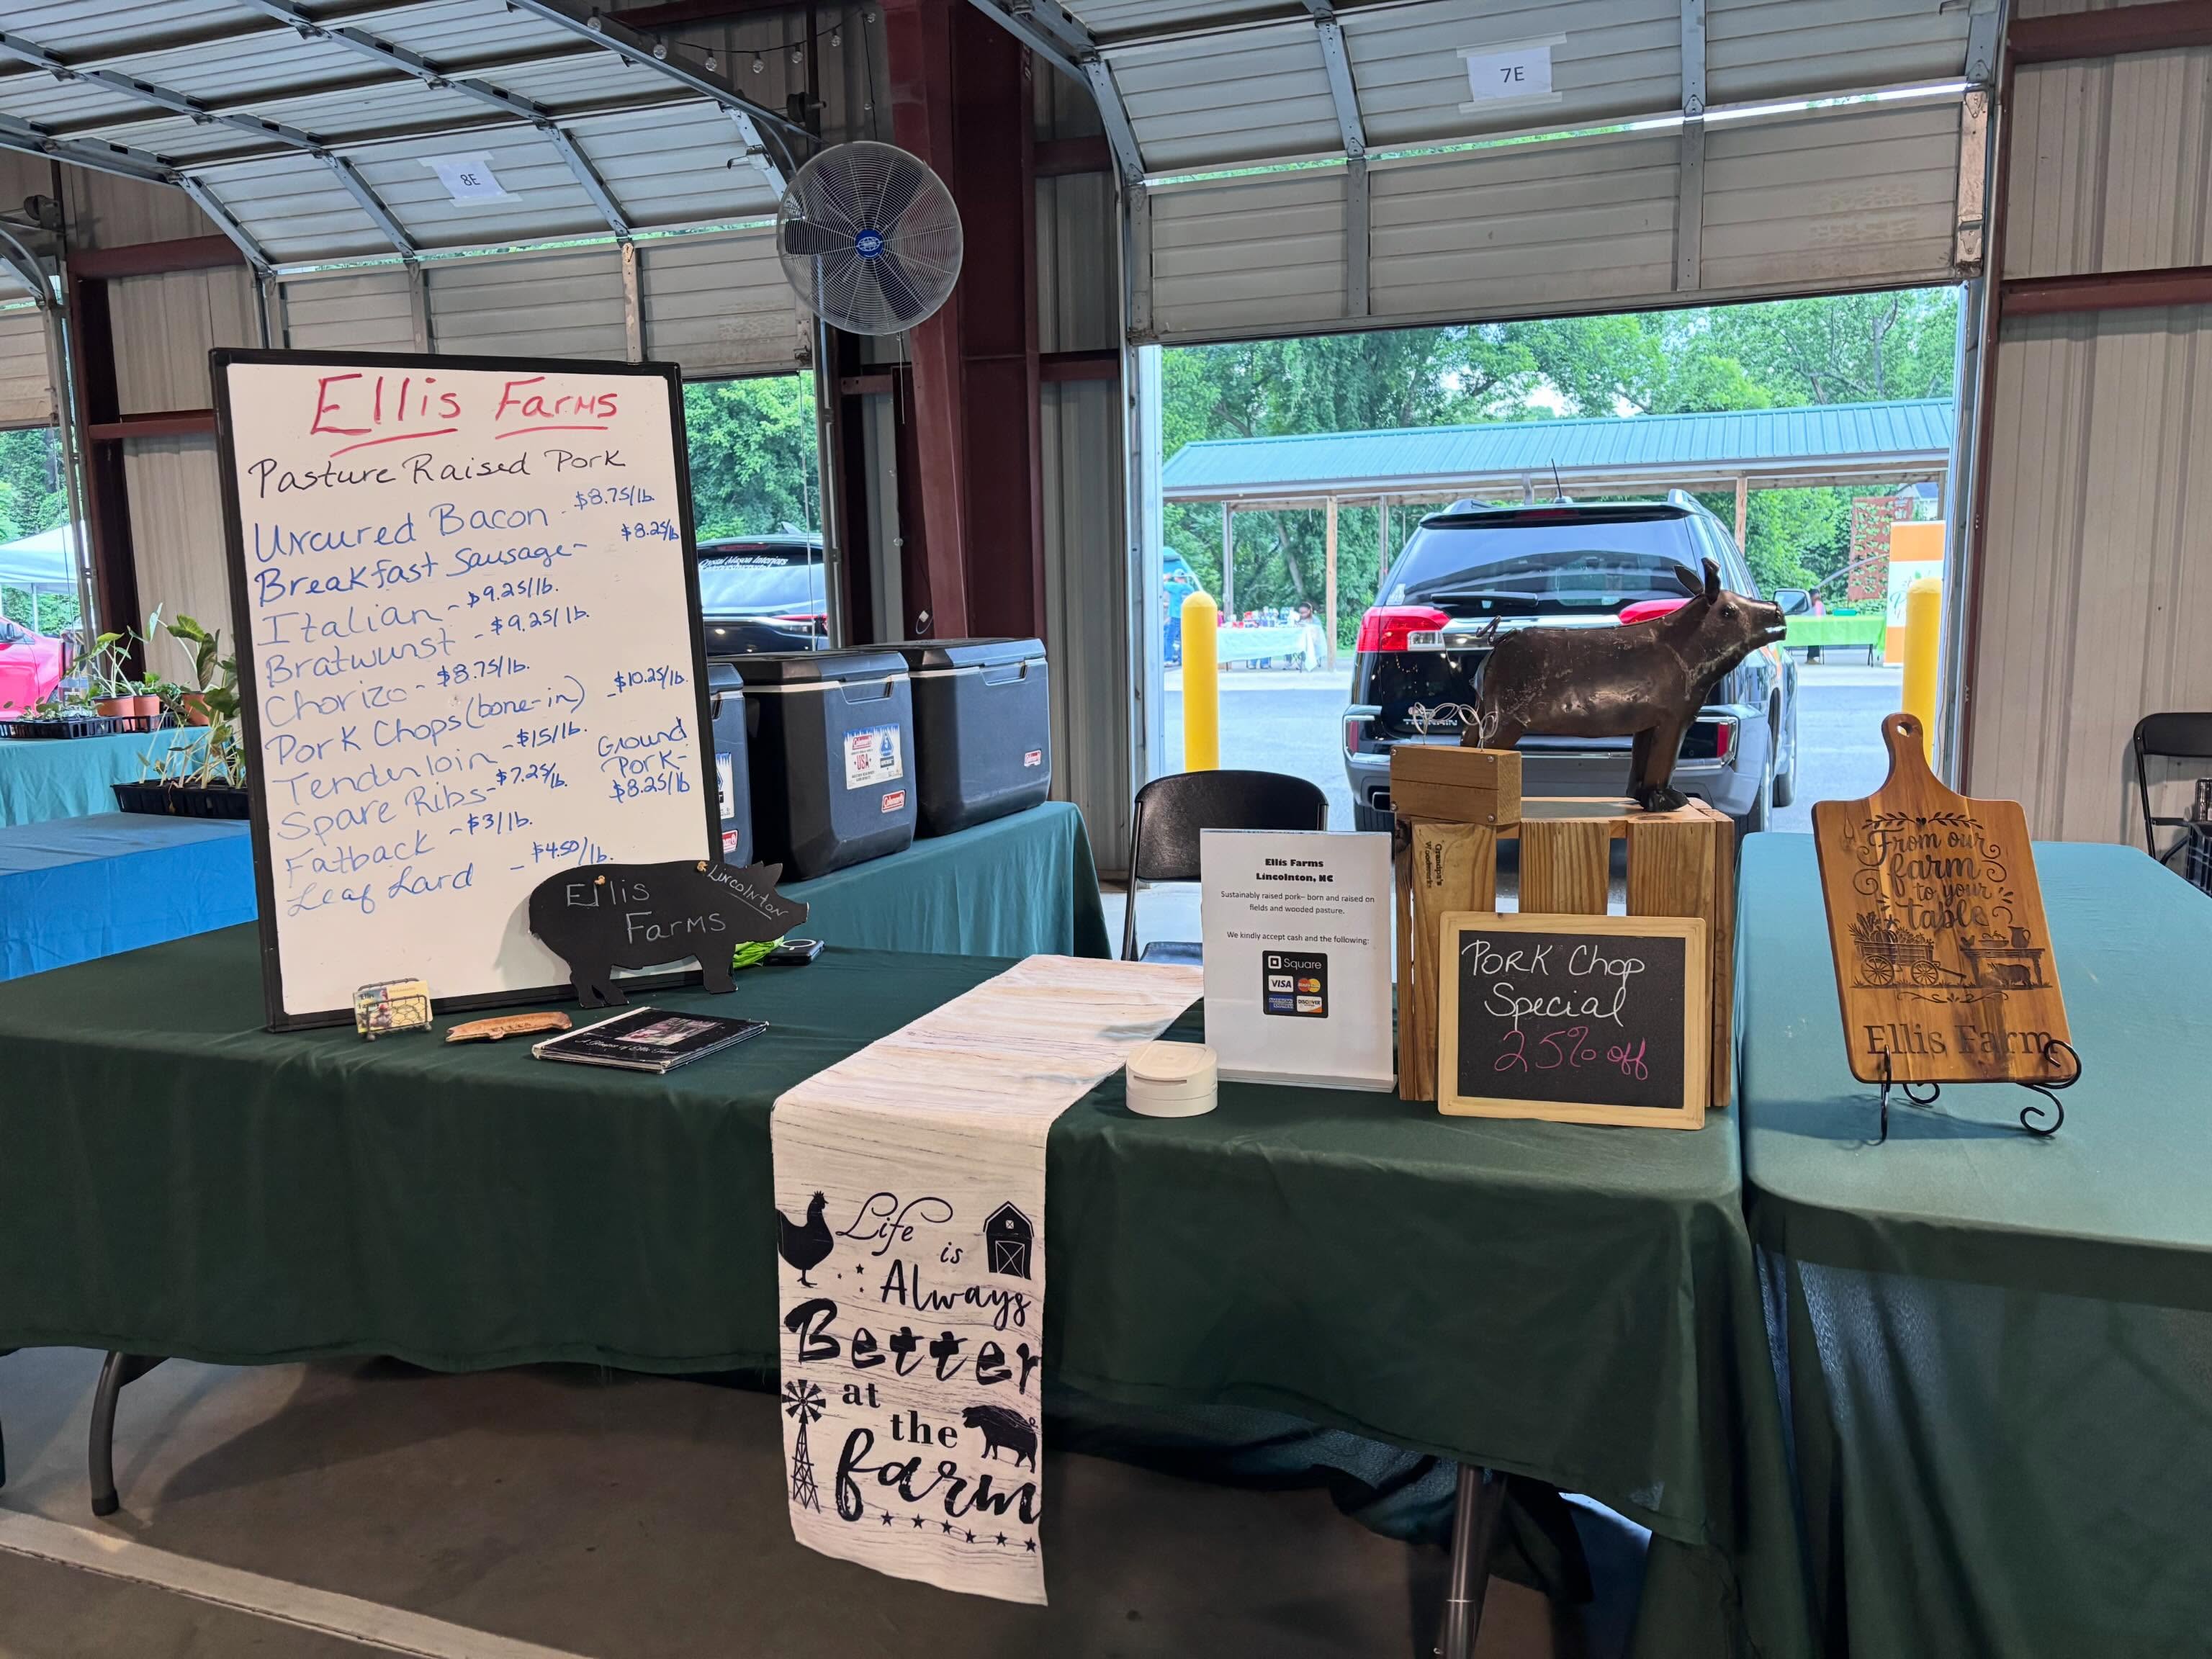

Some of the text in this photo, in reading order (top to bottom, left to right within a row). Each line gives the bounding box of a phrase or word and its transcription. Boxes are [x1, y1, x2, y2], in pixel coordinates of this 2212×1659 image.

[1500, 66, 1525, 83] 7E
[460, 174, 481, 186] 8E
[310, 373, 461, 435] Ellis
[248, 458, 396, 498] Pasture
[402, 451, 531, 485] Raised
[255, 513, 416, 562] Uncured
[429, 503, 549, 536] Bacon
[254, 552, 439, 607] Breakfast
[257, 604, 444, 646] Italian
[266, 680, 408, 727] Chorizo
[598, 716, 687, 757] Ground
[857, 754, 870, 770] USA
[277, 801, 397, 846] Spare
[285, 830, 436, 888] Fatback
[1290, 859, 1324, 868] Farms
[1857, 828, 1941, 866] From
[287, 882, 376, 917] Leaf
[388, 863, 474, 899] Lard
[566, 879, 650, 907] Ellis
[1220, 891, 1260, 900] Sustainably
[1256, 873, 1334, 883] Lincolnton, NC
[1887, 853, 1982, 898] farm
[1915, 883, 1992, 906] to your
[1895, 898, 1990, 930] table
[1240, 932, 1260, 940] kindly
[1334, 935, 1370, 945] following:
[1284, 958, 1322, 970] Square
[1569, 945, 1645, 989] Chop
[1485, 982, 1626, 1031] Special
[1494, 1027, 1596, 1072] 25%
[1863, 1024, 2058, 1058] Ellis Farm
[835, 1192, 953, 1256] Life
[940, 1241, 963, 1264] is
[881, 1259, 1031, 1331] Always
[784, 1298, 1041, 1394] Better
[842, 1384, 880, 1408] at
[890, 1411, 958, 1448] the
[835, 1428, 1041, 1524] farm
